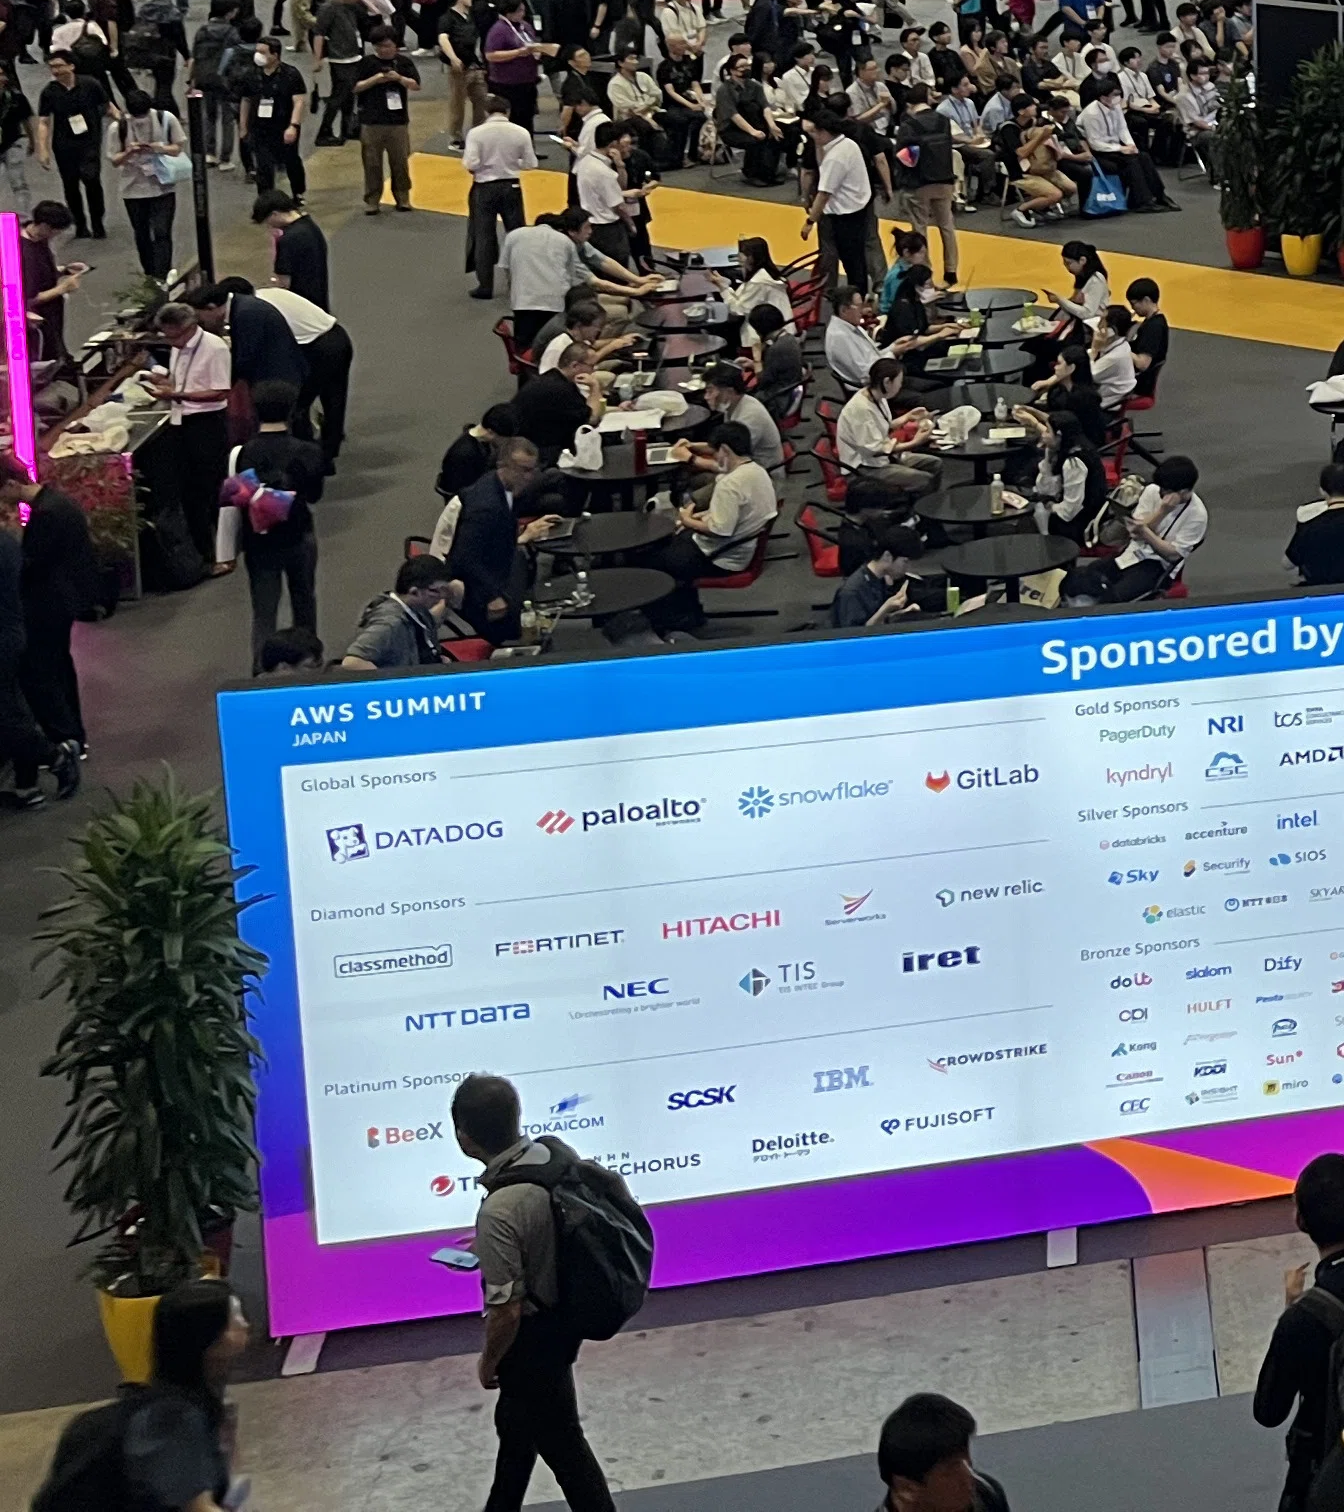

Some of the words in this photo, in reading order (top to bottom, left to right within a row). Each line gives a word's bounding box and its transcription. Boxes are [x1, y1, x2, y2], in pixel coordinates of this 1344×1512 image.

[1040, 618, 1277, 681] Sponsored
[1291, 616, 1344, 658] by
[290, 702, 355, 727] AWS
[366, 691, 486, 721] SUMMIT
[1074, 701, 1110, 718] Gold
[1113, 696, 1180, 715] Sponsors
[1207, 714, 1245, 736] NRI
[1273, 710, 1303, 729] tcs
[291, 729, 348, 747] JAPAN
[1098, 723, 1177, 744] PagerDuty
[1278, 748, 1327, 768] AMD
[300, 775, 355, 793] Global
[360, 770, 438, 790] Sponsors
[956, 763, 1040, 791] GitLab
[1105, 761, 1174, 788] kyndryl
[1205, 763, 1249, 779] CSC
[778, 779, 891, 807] snowflake
[581, 797, 701, 832] paloalto
[1077, 806, 1119, 823] Silver
[1122, 800, 1189, 820] Sponsors
[1276, 809, 1318, 830] intel
[375, 820, 505, 851] DATADOG
[1111, 834, 1167, 849] databricks
[1184, 825, 1249, 841] accenture
[1202, 857, 1251, 873] Securify
[1294, 848, 1328, 864] SIOS
[1125, 868, 1160, 885] Sky
[960, 887, 1000, 903] new
[1003, 879, 1043, 897] relic
[310, 902, 385, 923] Diamond
[390, 896, 467, 917] Sponsors
[1166, 904, 1207, 920] elastic
[661, 909, 782, 940] HITACHI
[494, 928, 625, 957] FORTINET
[1080, 944, 1131, 962] Bronze
[1135, 938, 1201, 957] Sponsors
[338, 949, 449, 975] classmethod
[901, 944, 982, 974] iret
[1264, 955, 1303, 972] Dify
[777, 961, 816, 984] TIS
[1185, 965, 1233, 980] slalom
[602, 977, 670, 1001] NEC
[1118, 1007, 1149, 1023] CDI
[1186, 998, 1233, 1015] HULFT
[405, 1010, 457, 1032] NTT
[936, 1043, 1048, 1068] CROWDSTRIKE
[1128, 1041, 1158, 1053] Kong
[812, 1065, 870, 1094] IBM
[1116, 1070, 1154, 1082] Canon
[1193, 1063, 1228, 1078] KDDI
[323, 1078, 398, 1097] Platinum
[1281, 1078, 1309, 1090] miro
[667, 1084, 738, 1111] SCSK
[521, 1115, 605, 1136] TOKAICOM
[904, 1106, 996, 1132] FUJISOFT
[385, 1121, 444, 1145] BeeX
